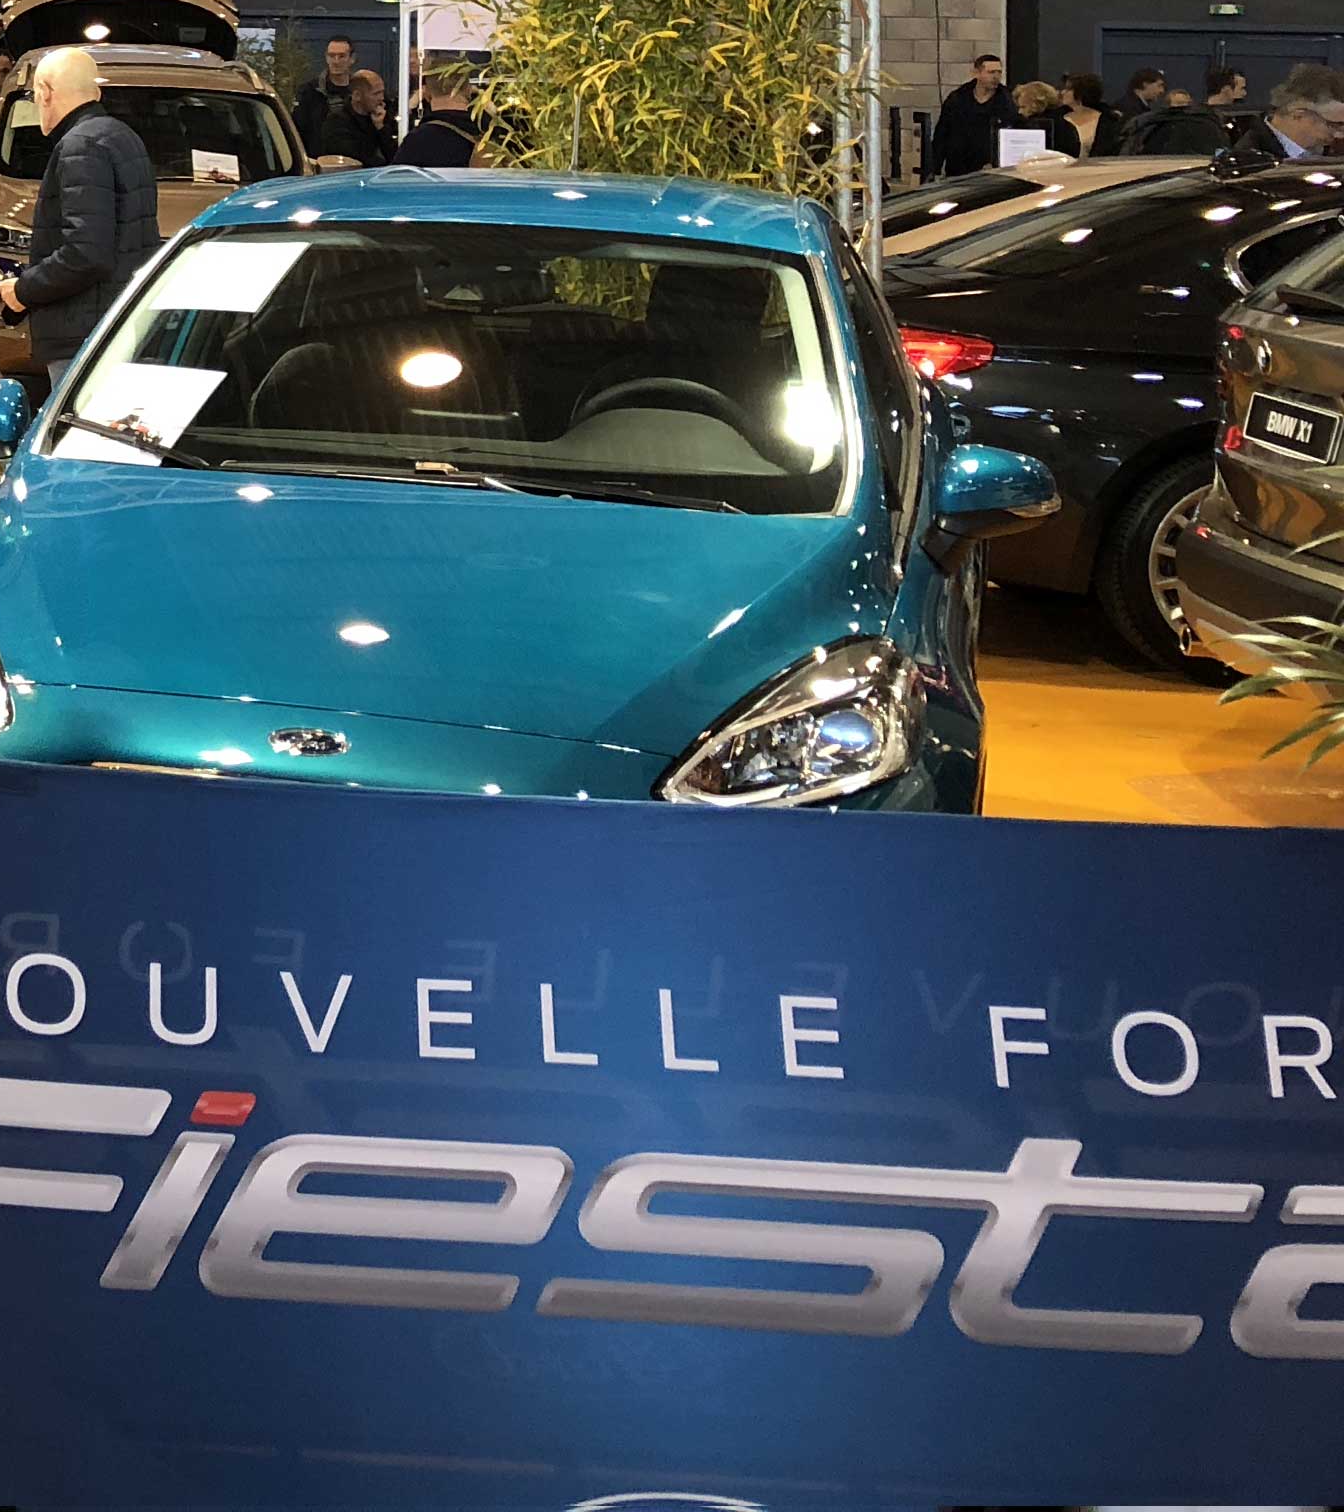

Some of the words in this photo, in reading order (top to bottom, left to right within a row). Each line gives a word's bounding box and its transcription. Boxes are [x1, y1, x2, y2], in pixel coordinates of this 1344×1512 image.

[1266, 410, 1298, 439] BMW
[1295, 419, 1313, 444] X1
[988, 1005, 1338, 1099] FOR
